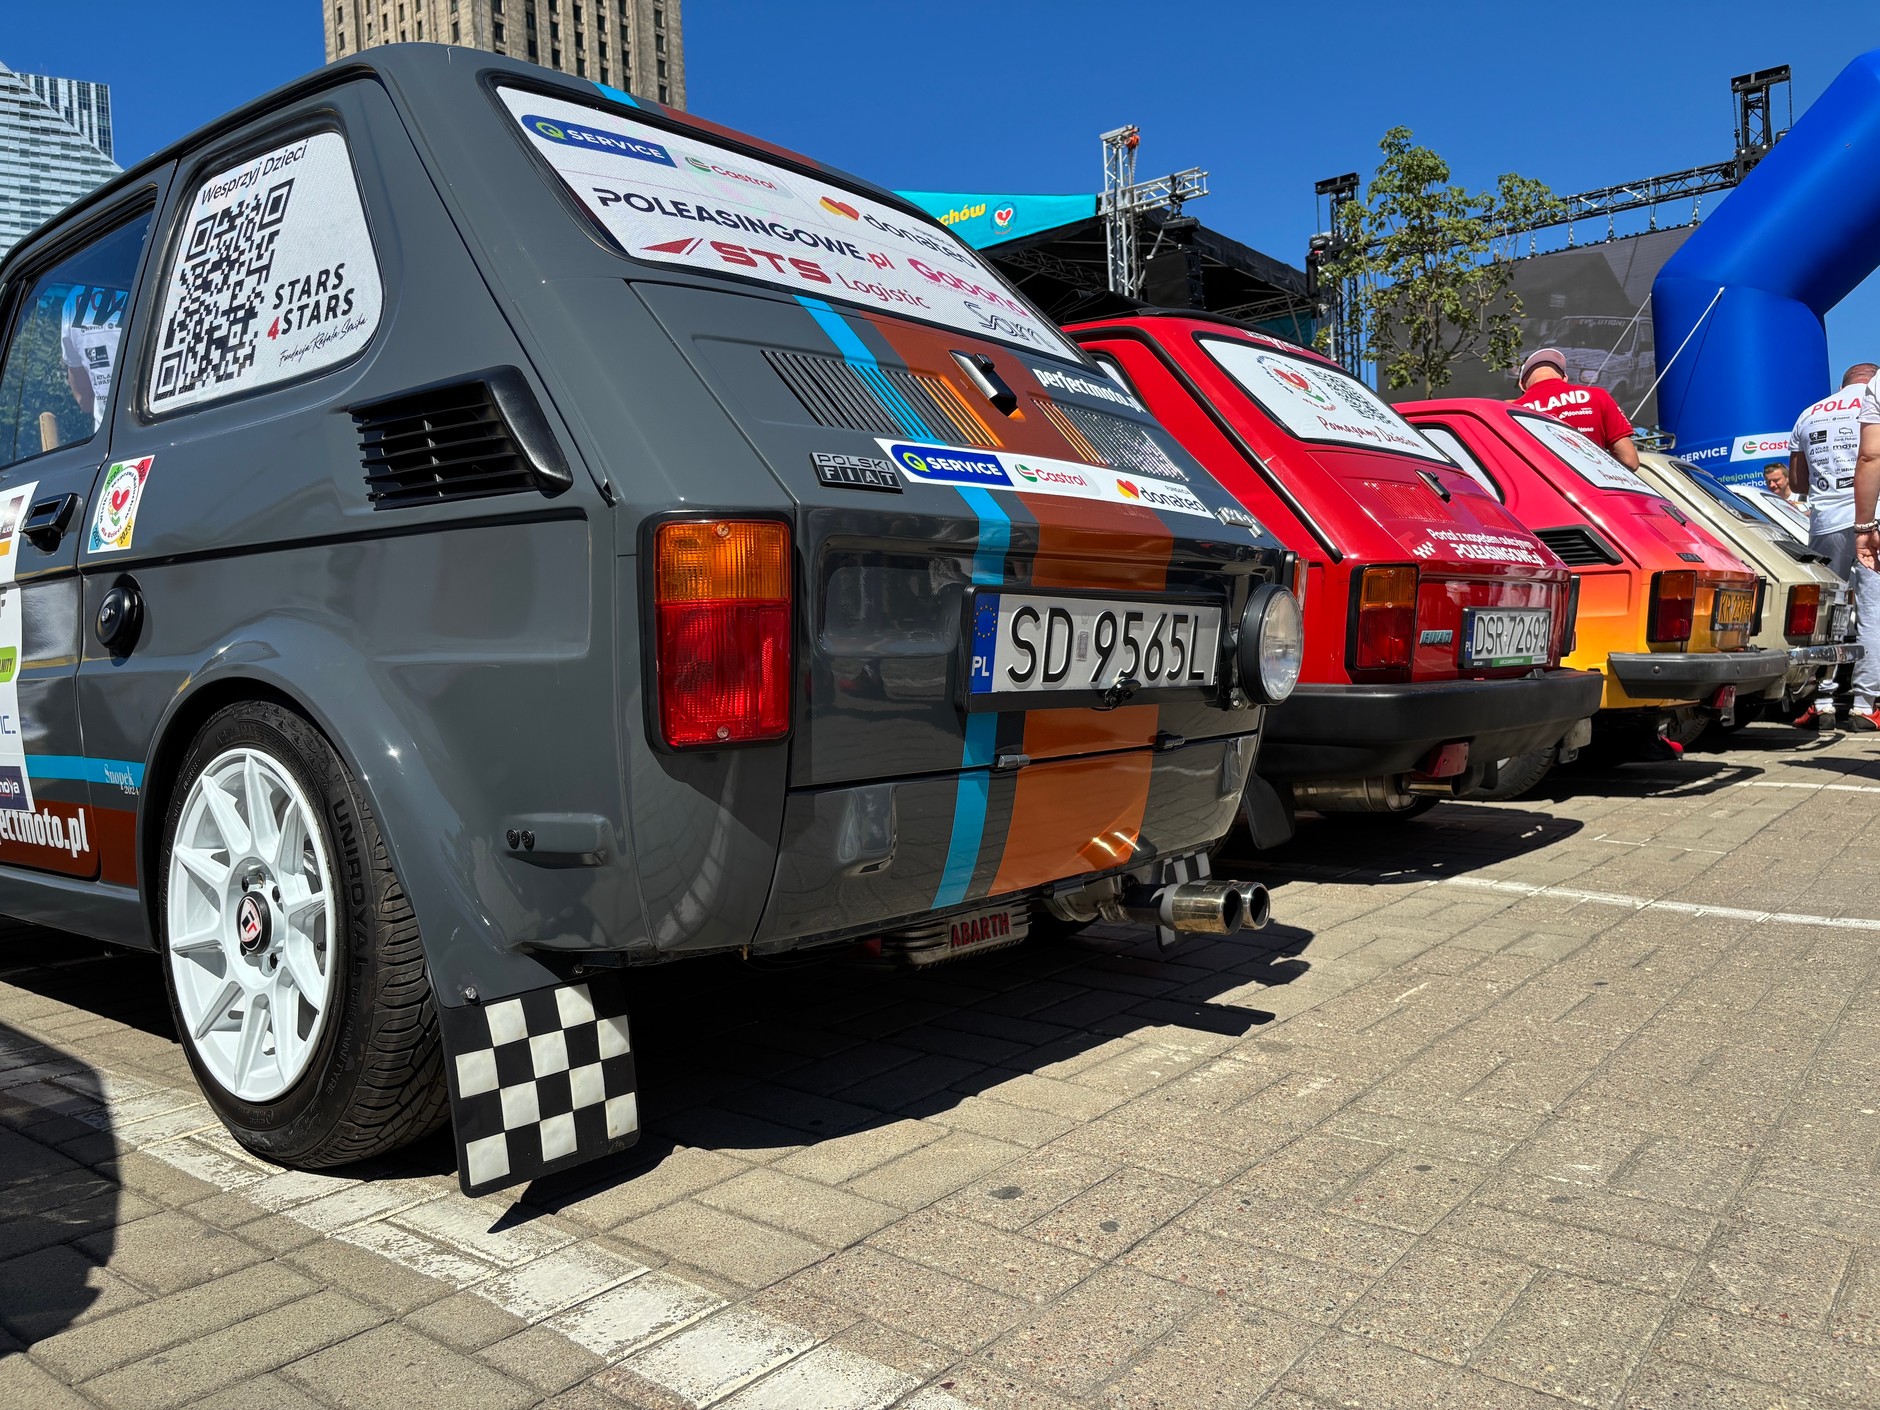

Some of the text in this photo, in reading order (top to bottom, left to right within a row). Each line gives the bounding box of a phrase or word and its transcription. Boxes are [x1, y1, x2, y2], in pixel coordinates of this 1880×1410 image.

[566, 129, 666, 160] SERVICE
[201, 139, 309, 206] Wesprzyj Dzieci
[710, 164, 778, 192] Castrol
[592, 187, 895, 270] POLEASINGOWE.pl
[863, 212, 977, 269] donateo
[272, 262, 345, 310] STARS
[709, 240, 833, 285] STS
[835, 272, 931, 309] Logistic
[267, 288, 355, 341] 4STARS
[1032, 368, 1147, 413] perfectmoto.pl
[816, 454, 891, 472] POLSKI
[927, 457, 1003, 476] SERVICE
[1681, 440, 1789, 462] SERVICE Cast
[823, 466, 894, 485] FIAT
[1035, 468, 1088, 487] Castrol
[1140, 486, 1207, 513] donateo
[1426, 528, 1456, 541] Portal
[1006, 604, 1205, 684] SD 9565L
[1473, 615, 1505, 656] DSR
[971, 656, 990, 677] PL
[332, 798, 370, 978] UNIROYAL
[949, 912, 1012, 951] ABARTH
